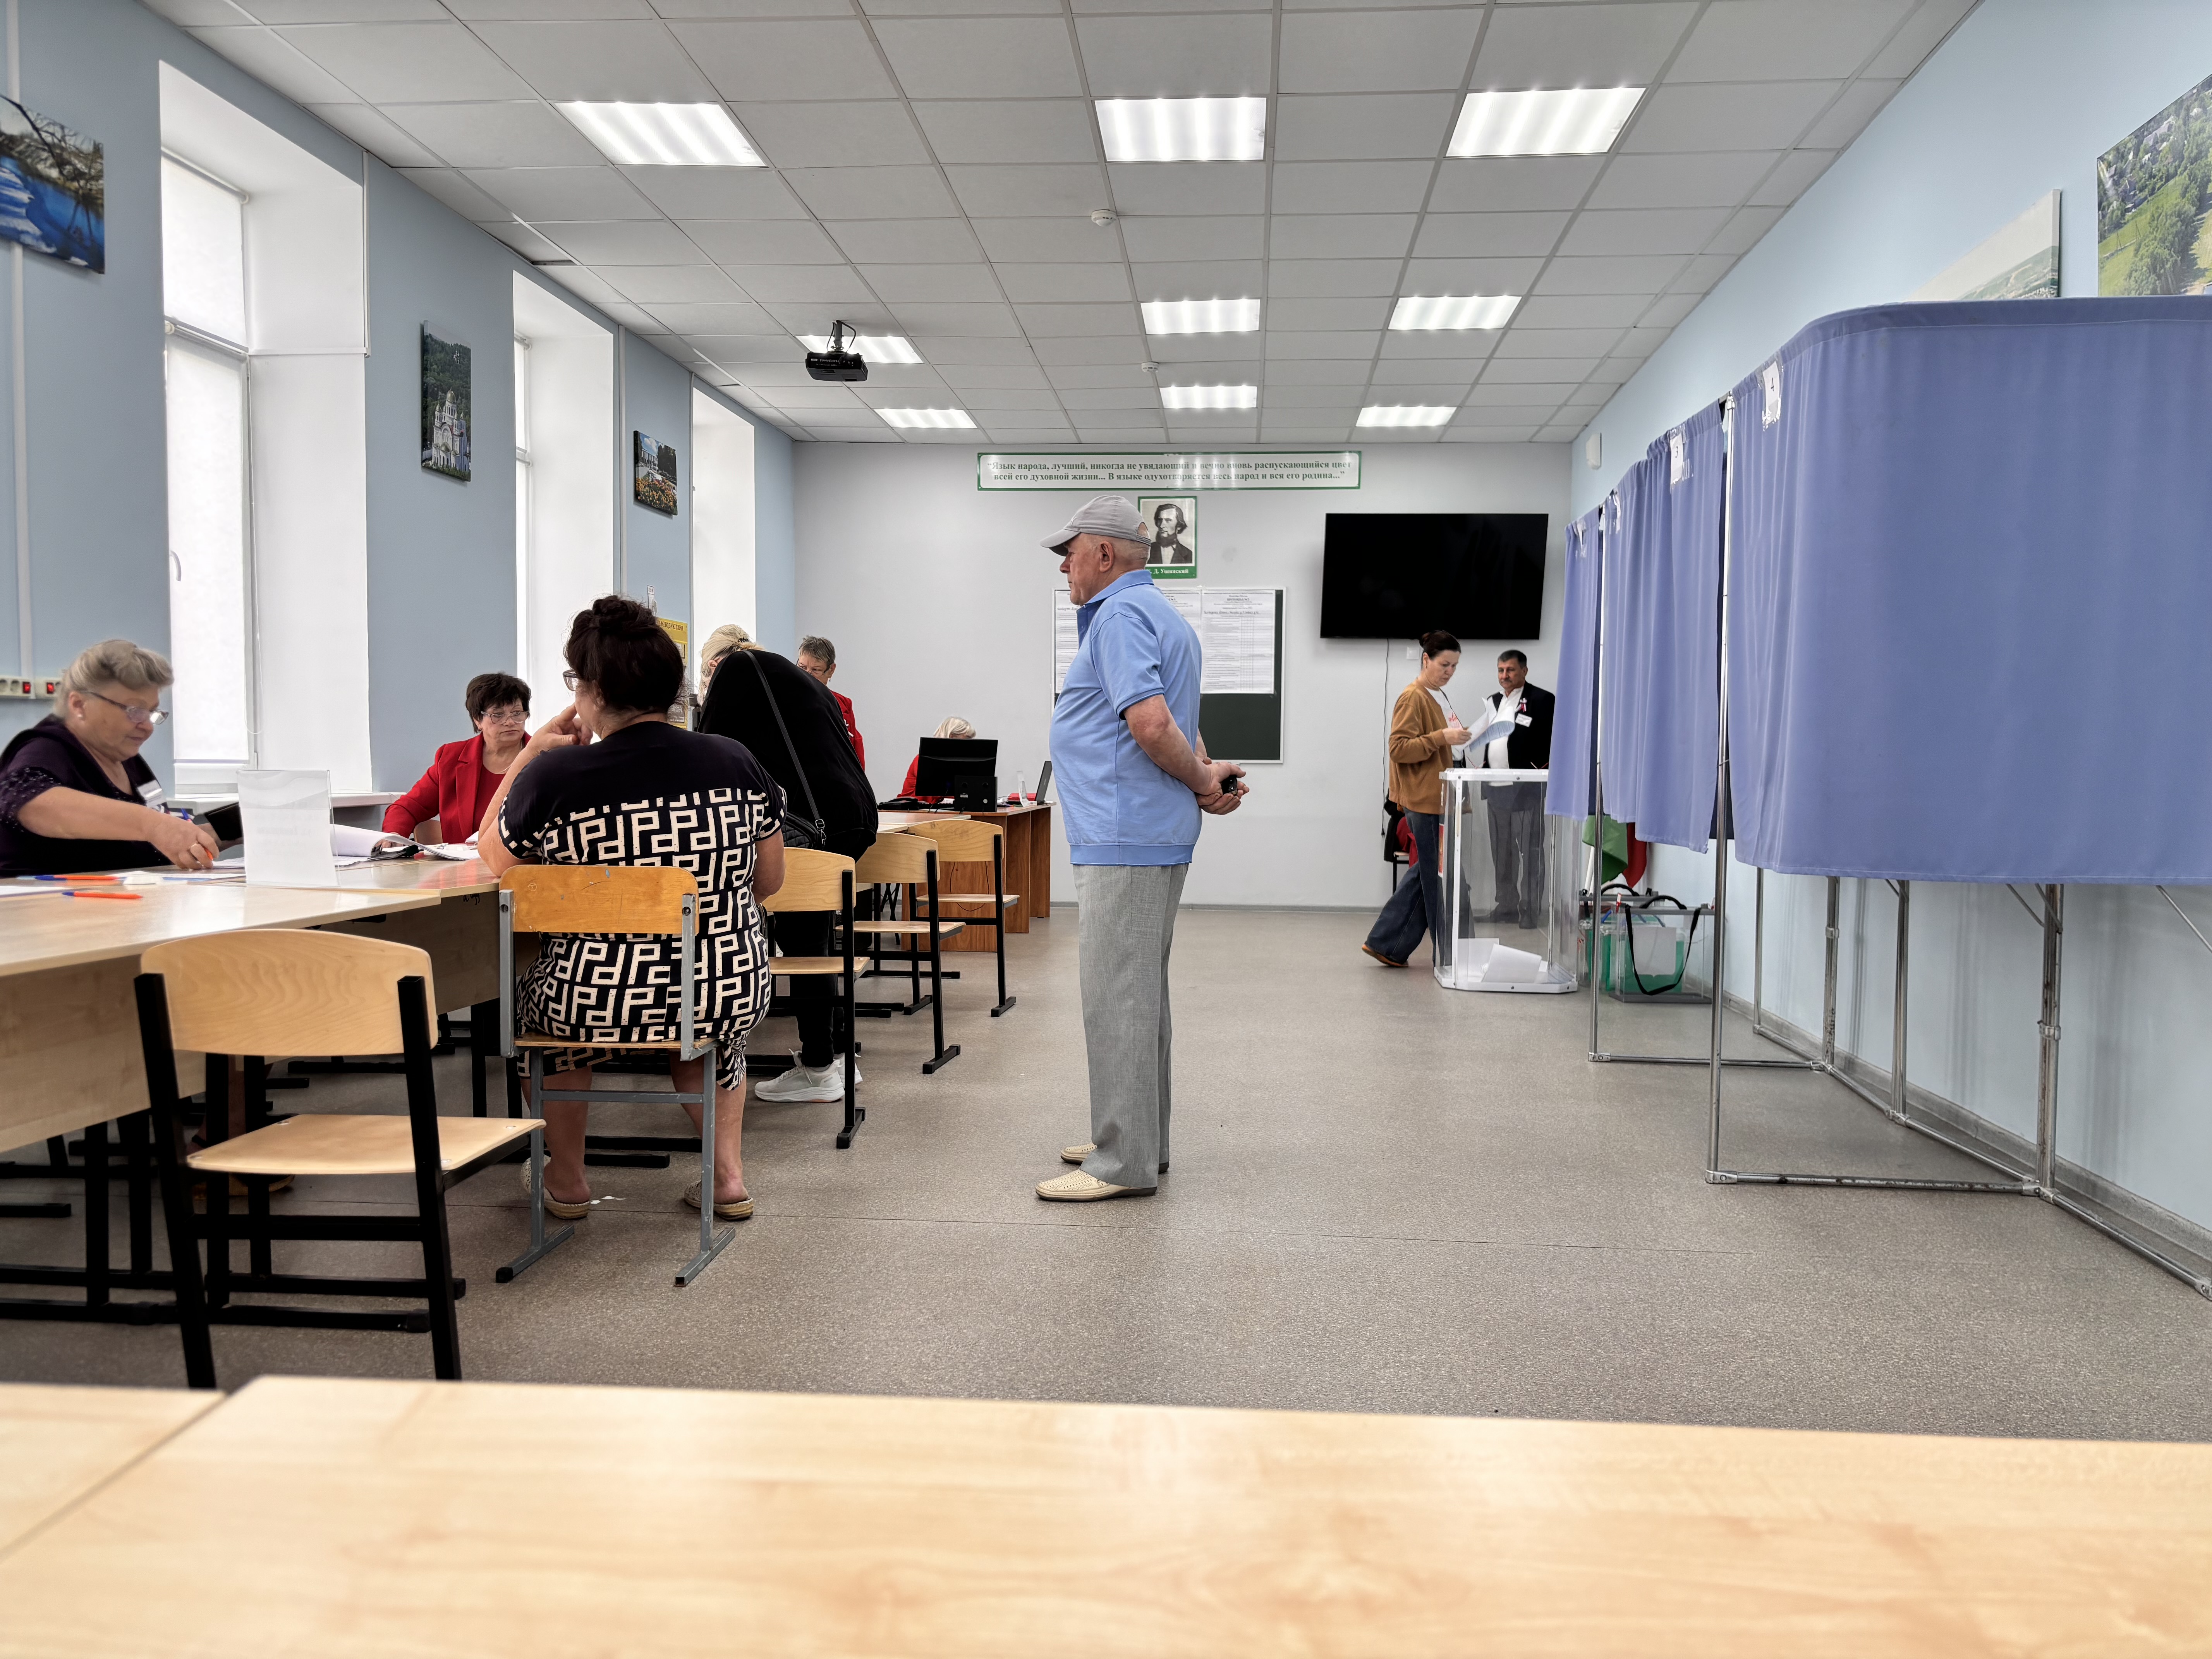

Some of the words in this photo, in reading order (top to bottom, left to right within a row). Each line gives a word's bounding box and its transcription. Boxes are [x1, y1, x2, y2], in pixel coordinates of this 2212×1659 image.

[1771, 377, 1774, 392] 4
[1051, 462, 1088, 471] лучший,
[1255, 461, 1329, 470] распускающийся
[1030, 473, 1069, 481] духовной
[1235, 473, 1259, 481] народ
